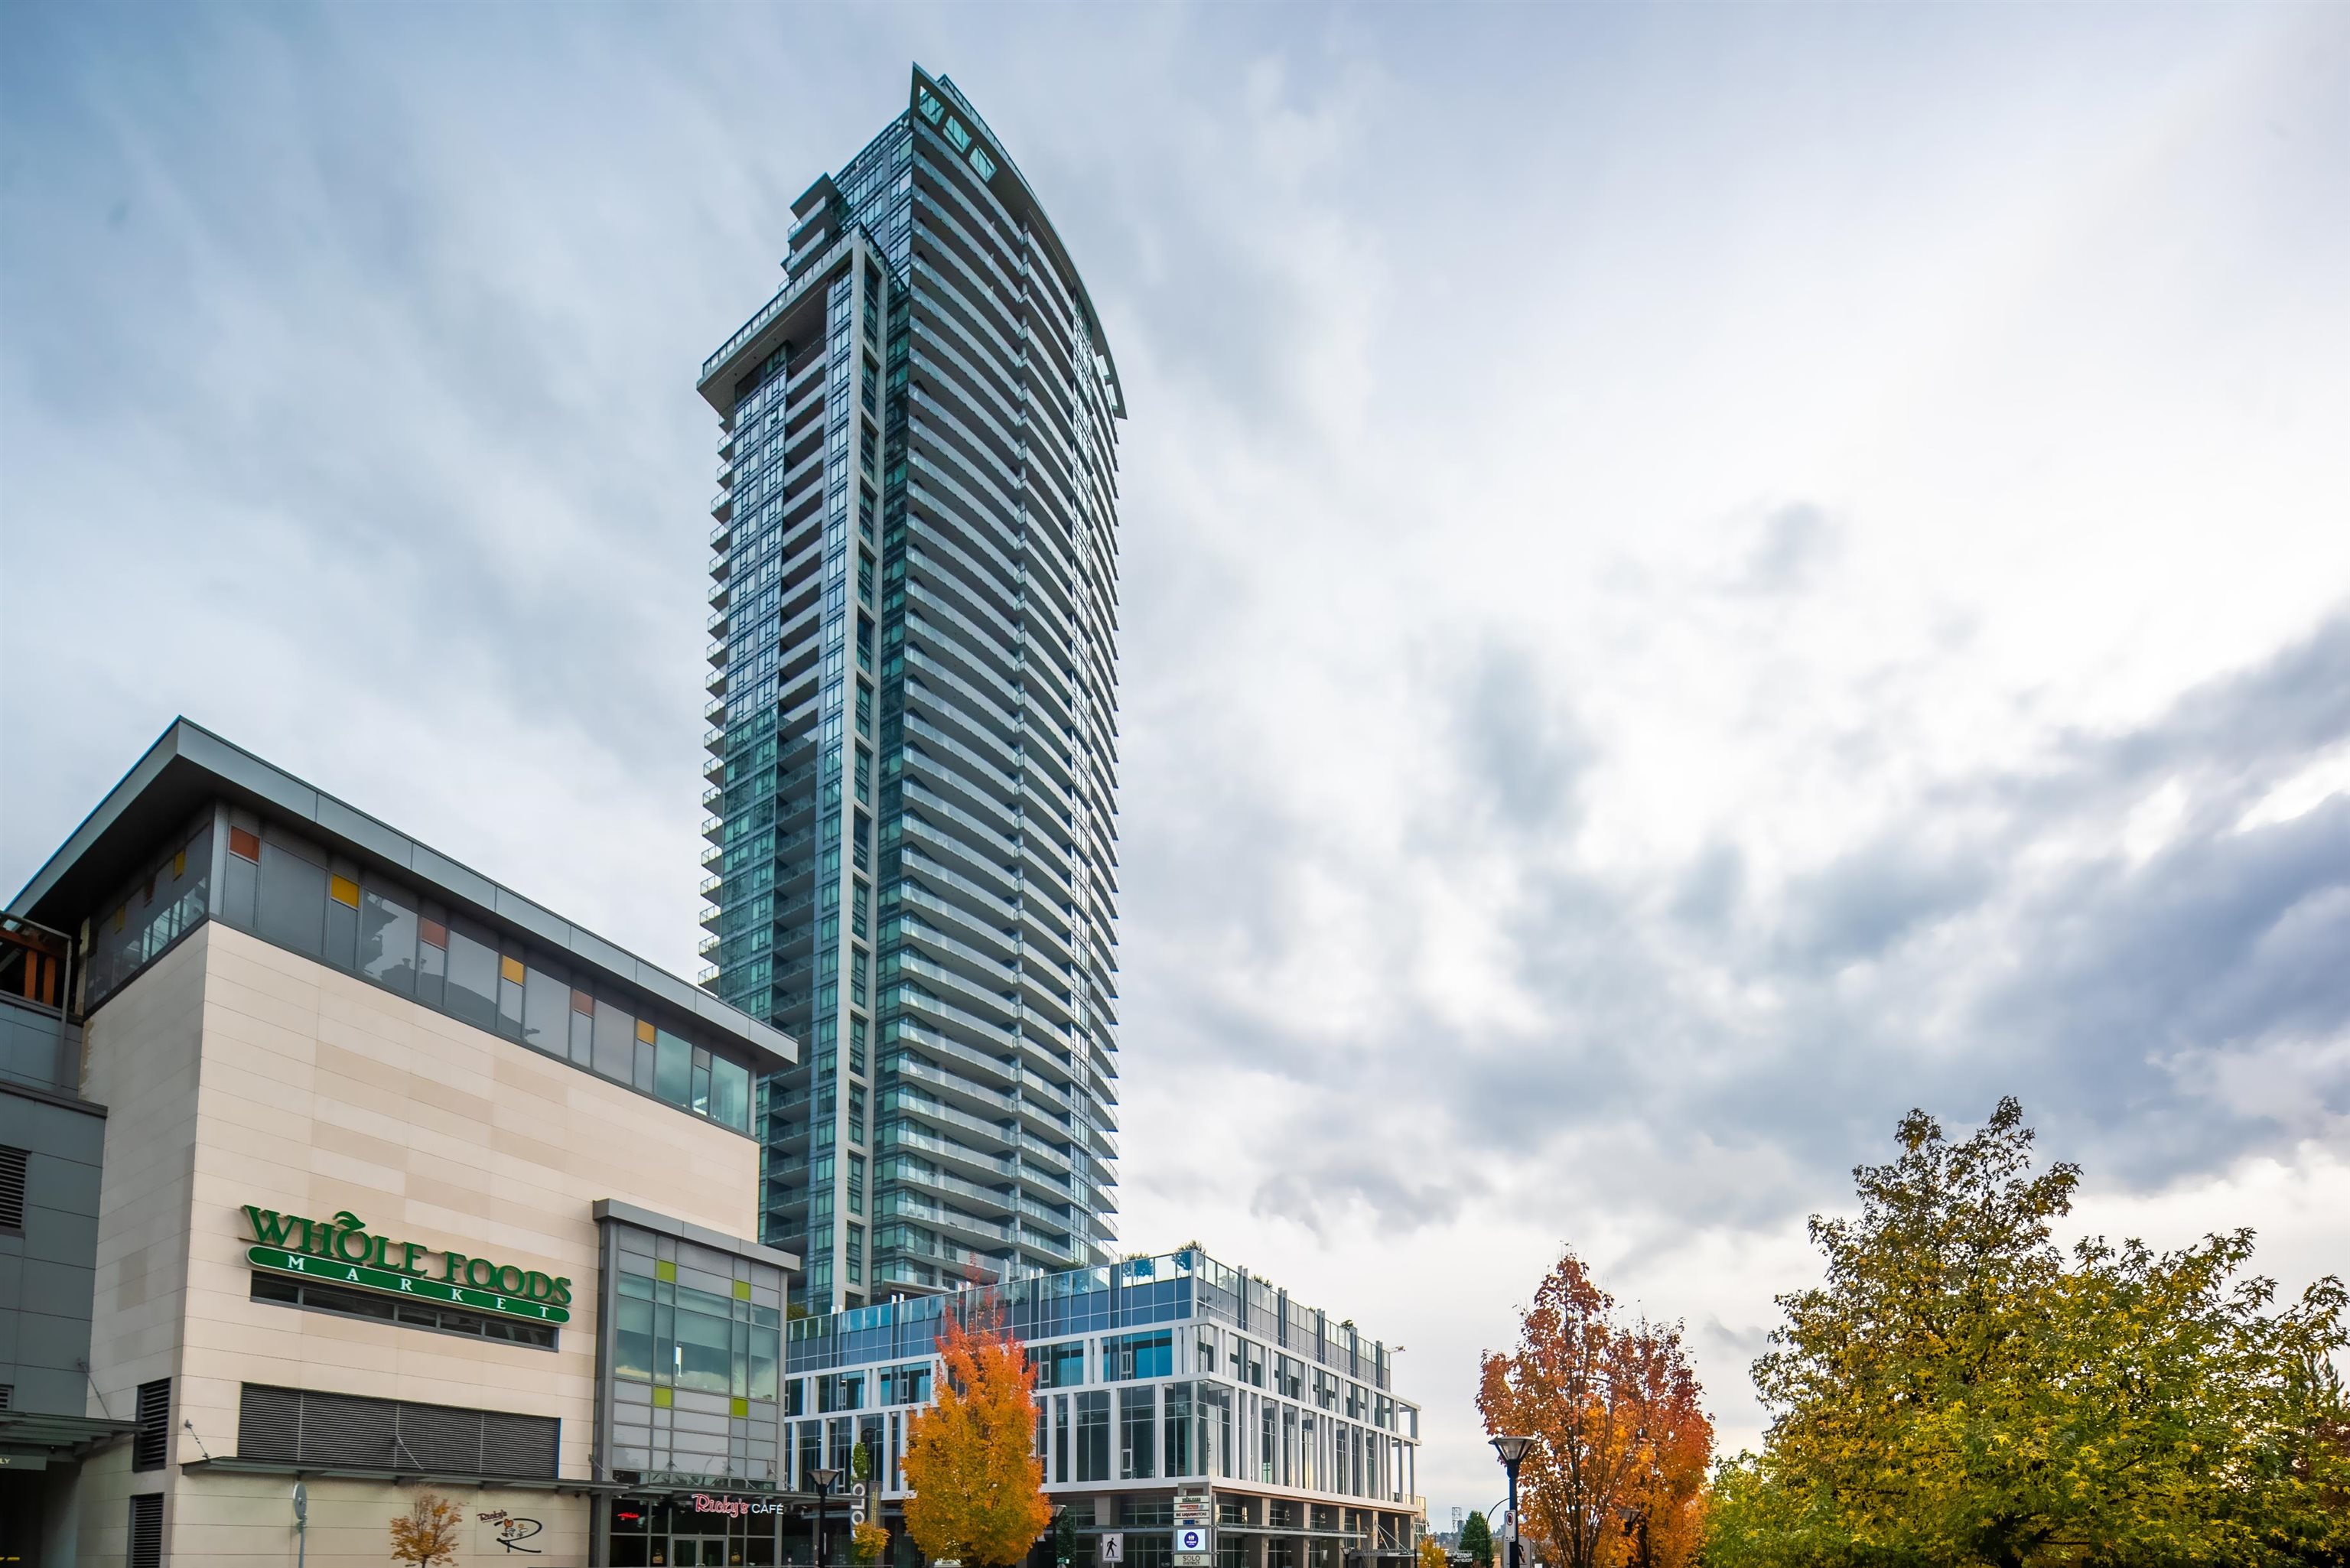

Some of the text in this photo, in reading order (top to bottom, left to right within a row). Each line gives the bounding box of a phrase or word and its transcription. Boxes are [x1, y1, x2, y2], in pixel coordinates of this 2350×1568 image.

[241, 1205, 573, 1306] WHOLE FOODS
[287, 1254, 551, 1319] MARKET
[691, 1493, 784, 1518] Ricky's CAFÉ
[851, 1483, 866, 1539] OLO
